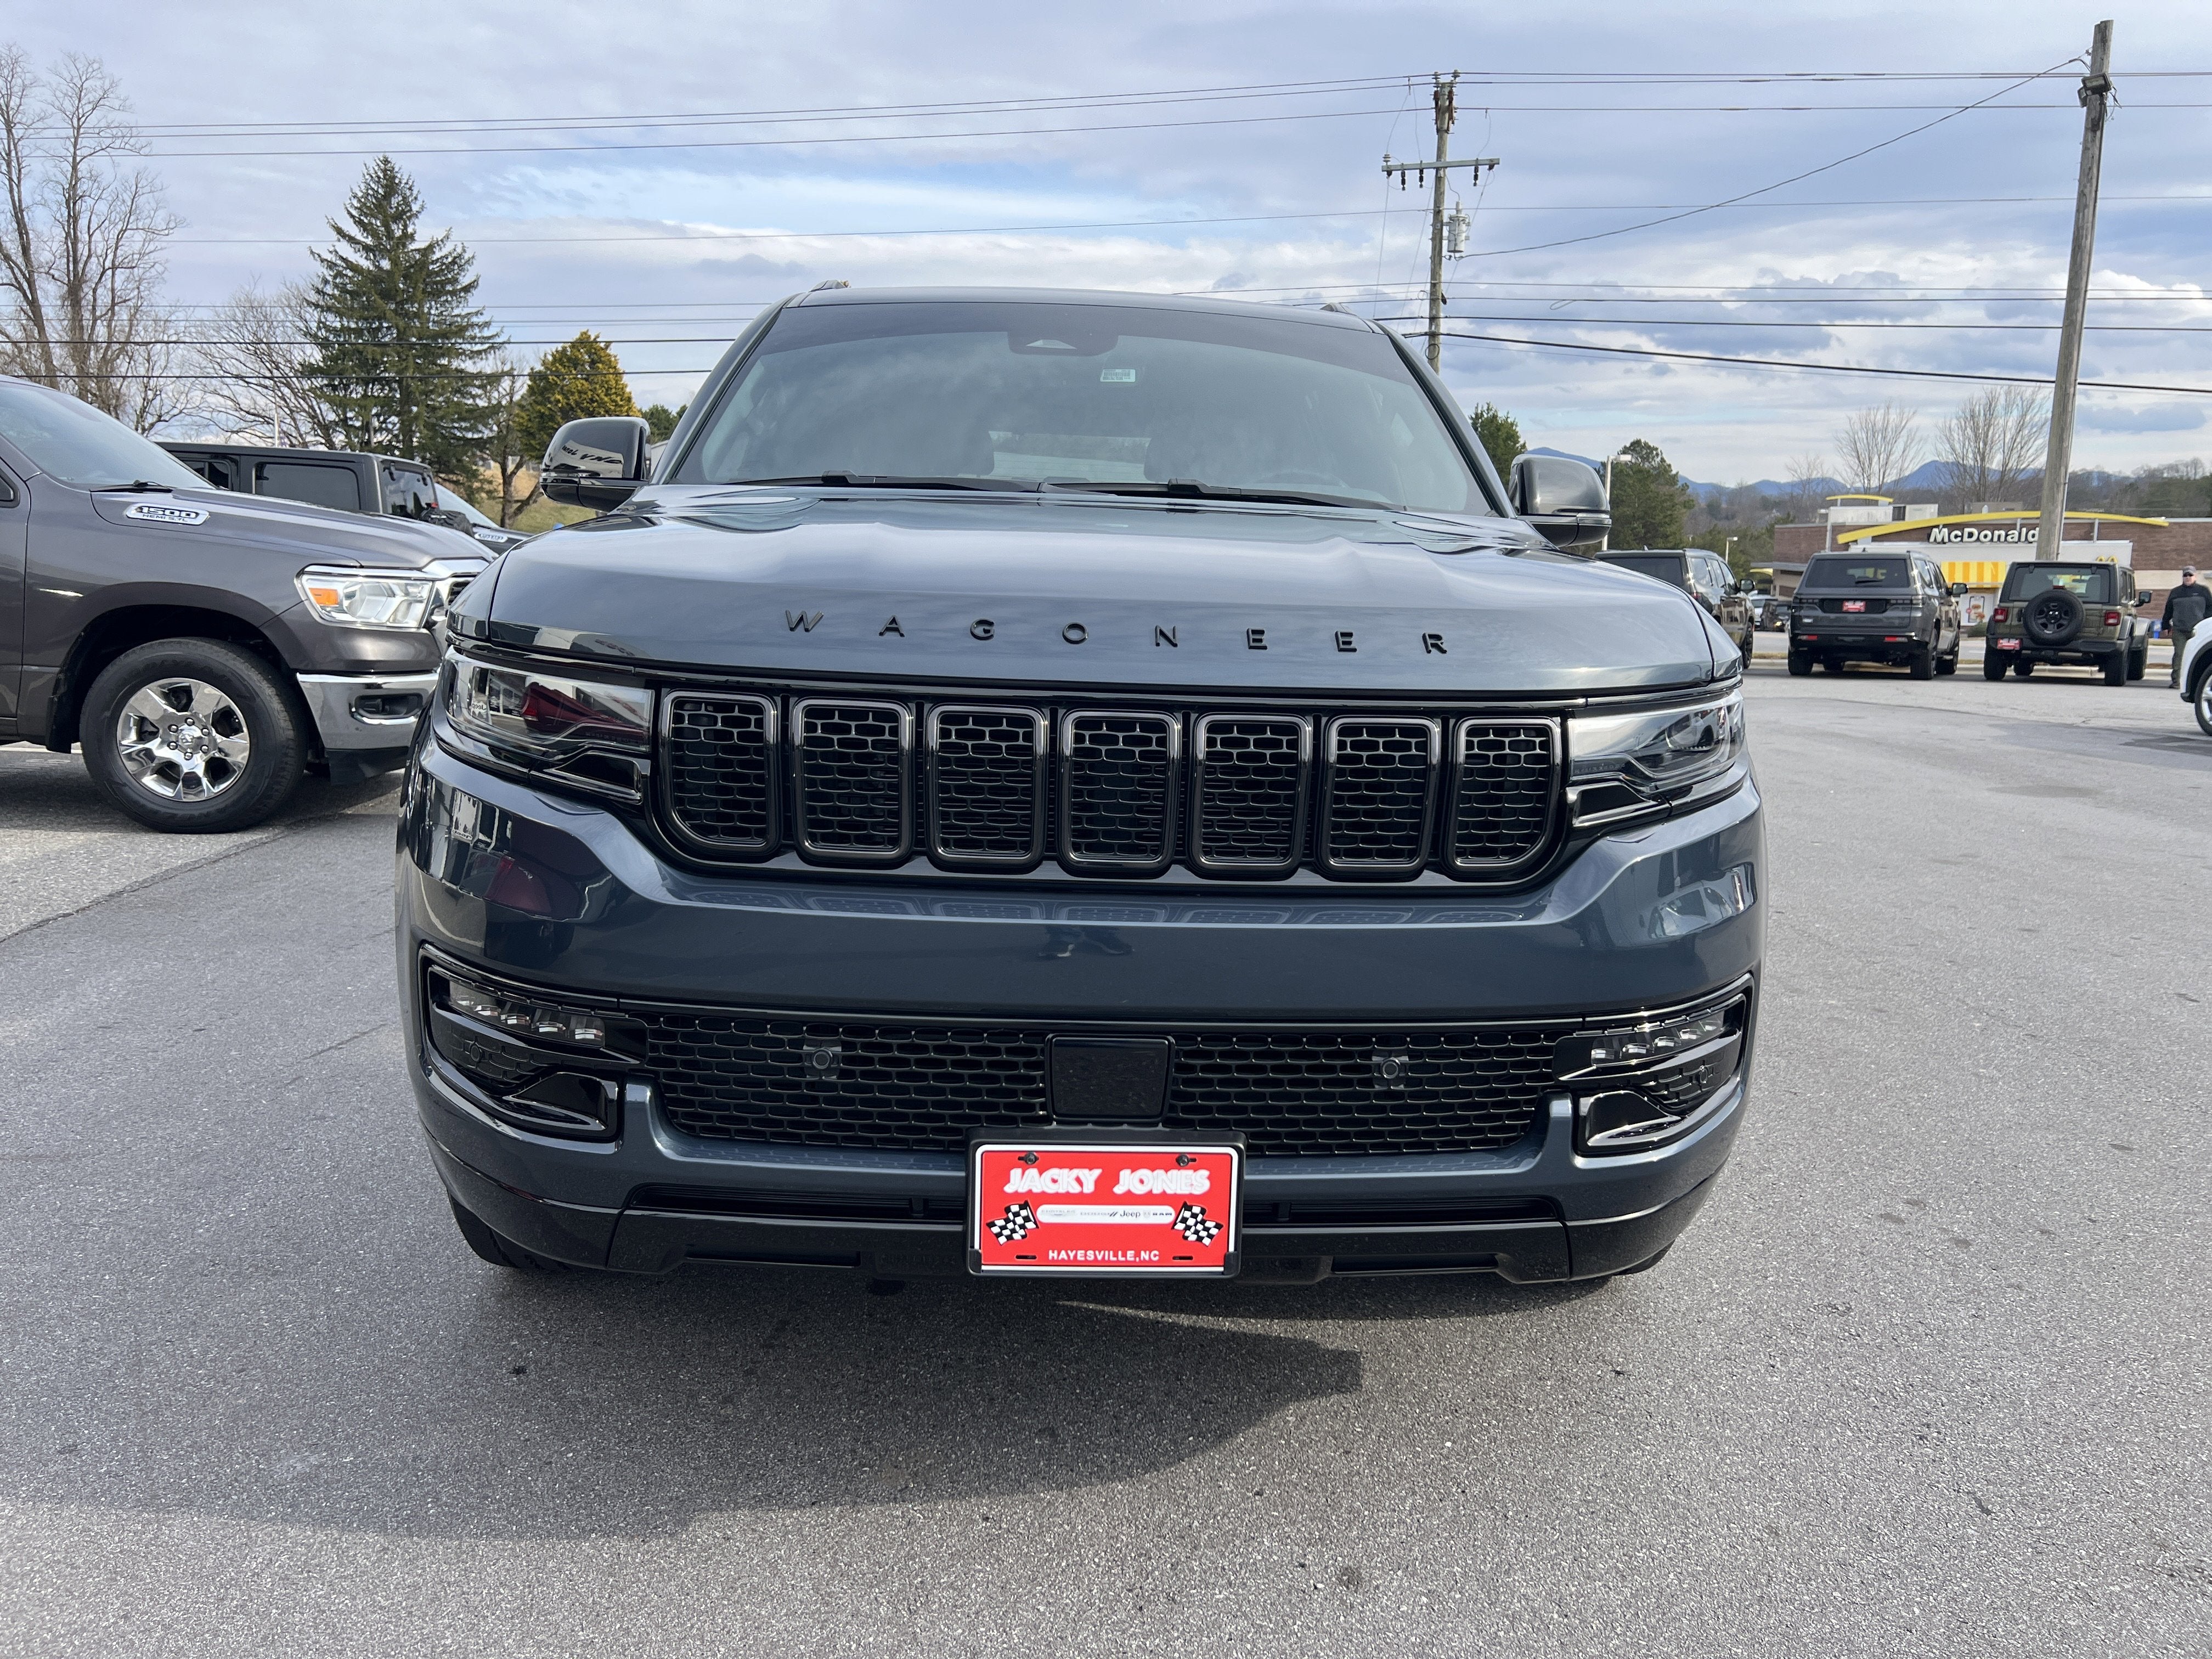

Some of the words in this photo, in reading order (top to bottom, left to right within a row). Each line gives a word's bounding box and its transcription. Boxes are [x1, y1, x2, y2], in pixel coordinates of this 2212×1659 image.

[141, 506, 196, 518] 1500
[785, 610, 1447, 654] WAGONEER
[1003, 1168, 1102, 1194] JACKY
[1113, 1169, 1210, 1194] JONES
[1120, 1210, 1141, 1218] Jeep
[1048, 1250, 1159, 1262] HAYESVILLE,NC
